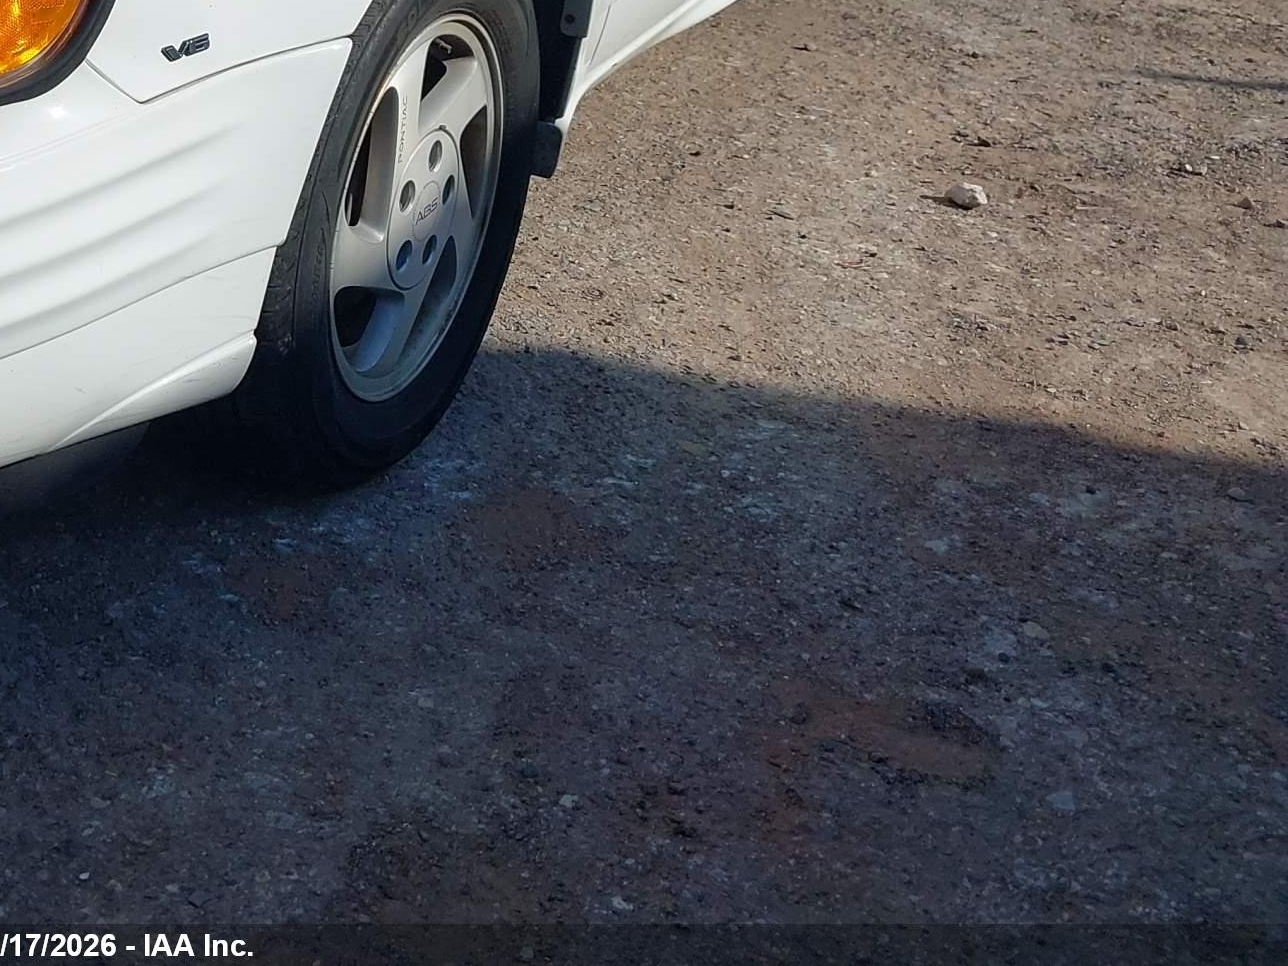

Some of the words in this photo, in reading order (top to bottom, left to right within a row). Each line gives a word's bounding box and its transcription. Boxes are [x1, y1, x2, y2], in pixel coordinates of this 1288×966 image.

[160, 32, 211, 63] V6
[397, 93, 408, 164] PONTIAC
[415, 194, 441, 226] ABS
